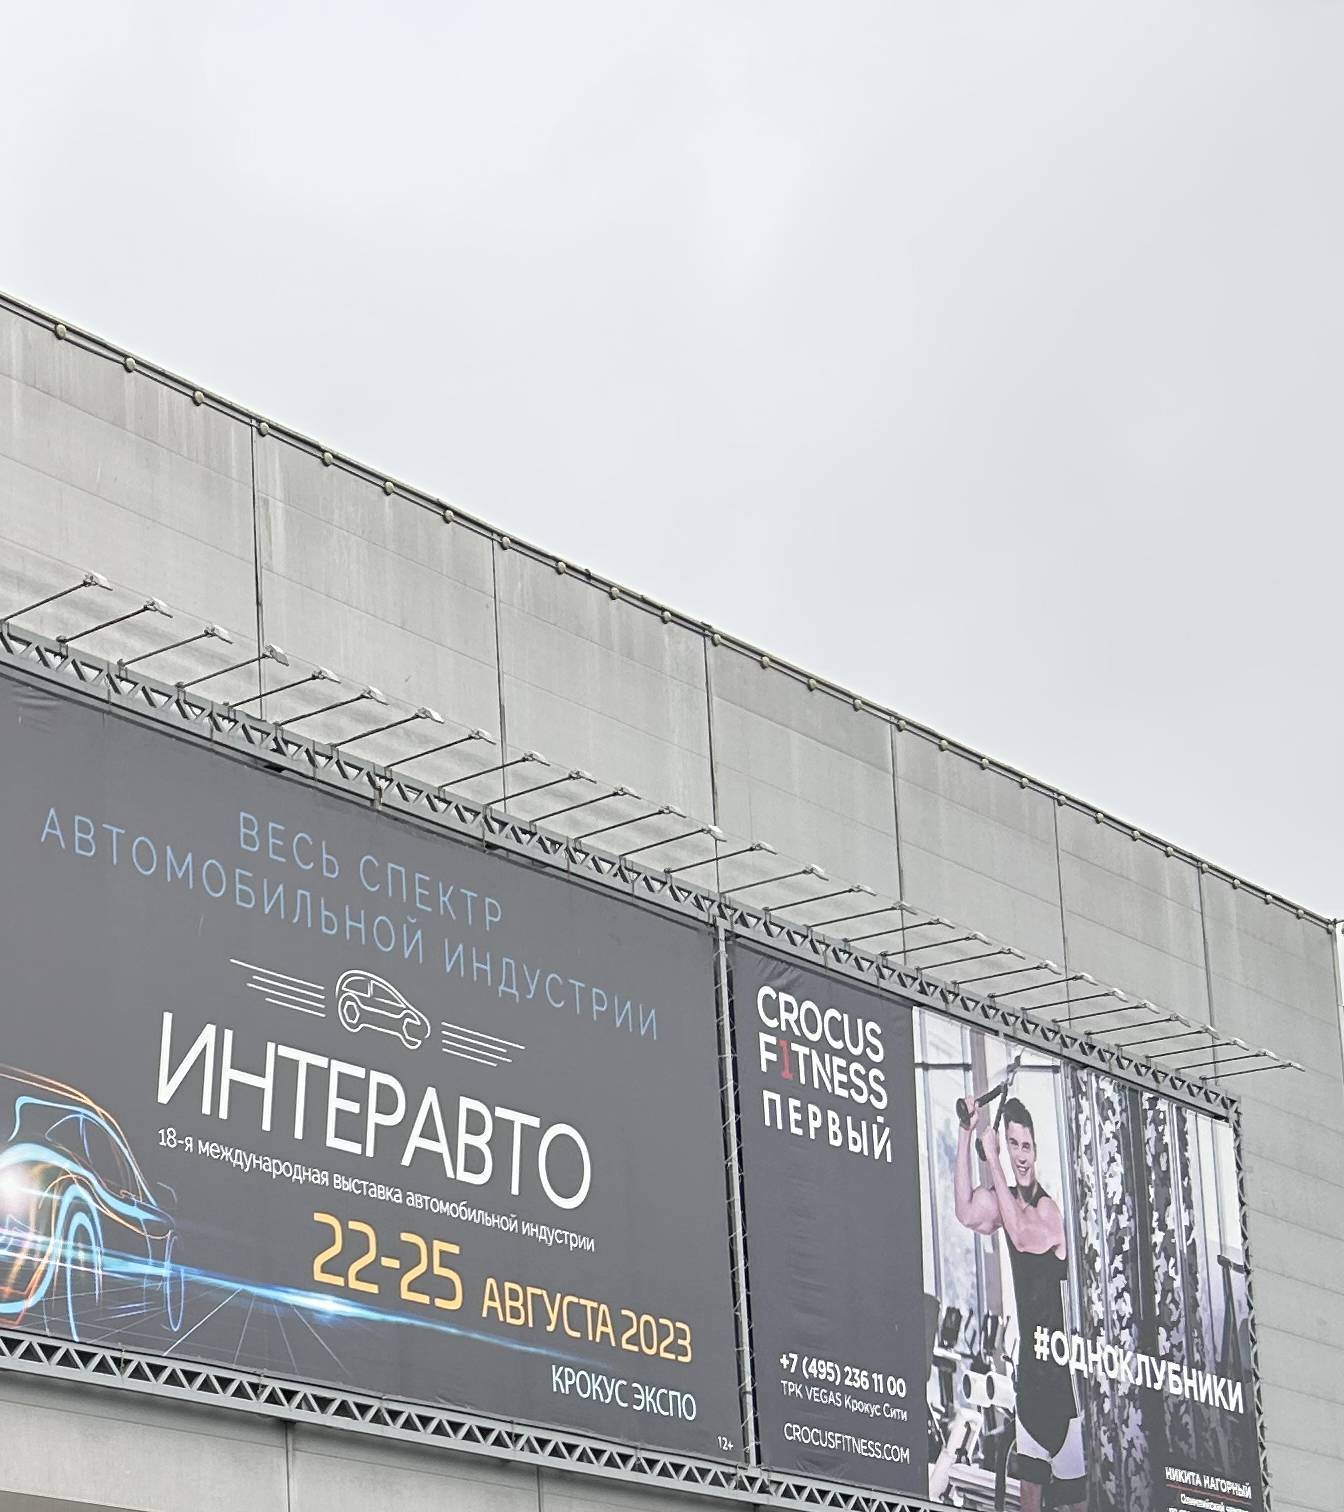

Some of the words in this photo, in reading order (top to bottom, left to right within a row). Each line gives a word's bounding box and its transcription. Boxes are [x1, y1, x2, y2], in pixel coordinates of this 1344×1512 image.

[239, 814, 340, 879] ВЕСЬ
[360, 855, 501, 930] СПЕКТР
[40, 808, 423, 964] АВТОМОБИЛЬНОЙ
[445, 939, 658, 1040] ИНДУСТРИИ
[757, 985, 885, 1063] CROCUS
[158, 1011, 591, 1209] ИНТЕРАВТО
[762, 1089, 893, 1163] ПЕРВЫЙ
[158, 1127, 193, 1152] 18-я
[198, 1140, 329, 1187] международная
[333, 1172, 403, 1204] выставка
[406, 1190, 518, 1233] автомобильной
[521, 1221, 595, 1252] индустрии
[313, 1211, 463, 1310] 22-25
[482, 1277, 615, 1348] АВГУСТА
[621, 1309, 692, 1364] 2023
[552, 1365, 628, 1409] КРОКУС
[632, 1382, 697, 1422] ЭКСПО
[779, 1352, 799, 1373] +7
[802, 1356, 841, 1386] (495)
[844, 1365, 870, 1390] 236
[871, 1372, 884, 1394] 11
[886, 1375, 907, 1398] 00
[805, 1385, 842, 1407] VEGAS
[844, 1394, 882, 1418] Крокус
[882, 1402, 908, 1422] Сити
[1033, 1325, 1245, 1414] #ОДНОКЛУБНИКИ
[717, 1435, 734, 1451] 12+
[783, 1422, 910, 1465] CROCUSFITNESS.COM
[1164, 1466, 1203, 1487] НИКИТА
